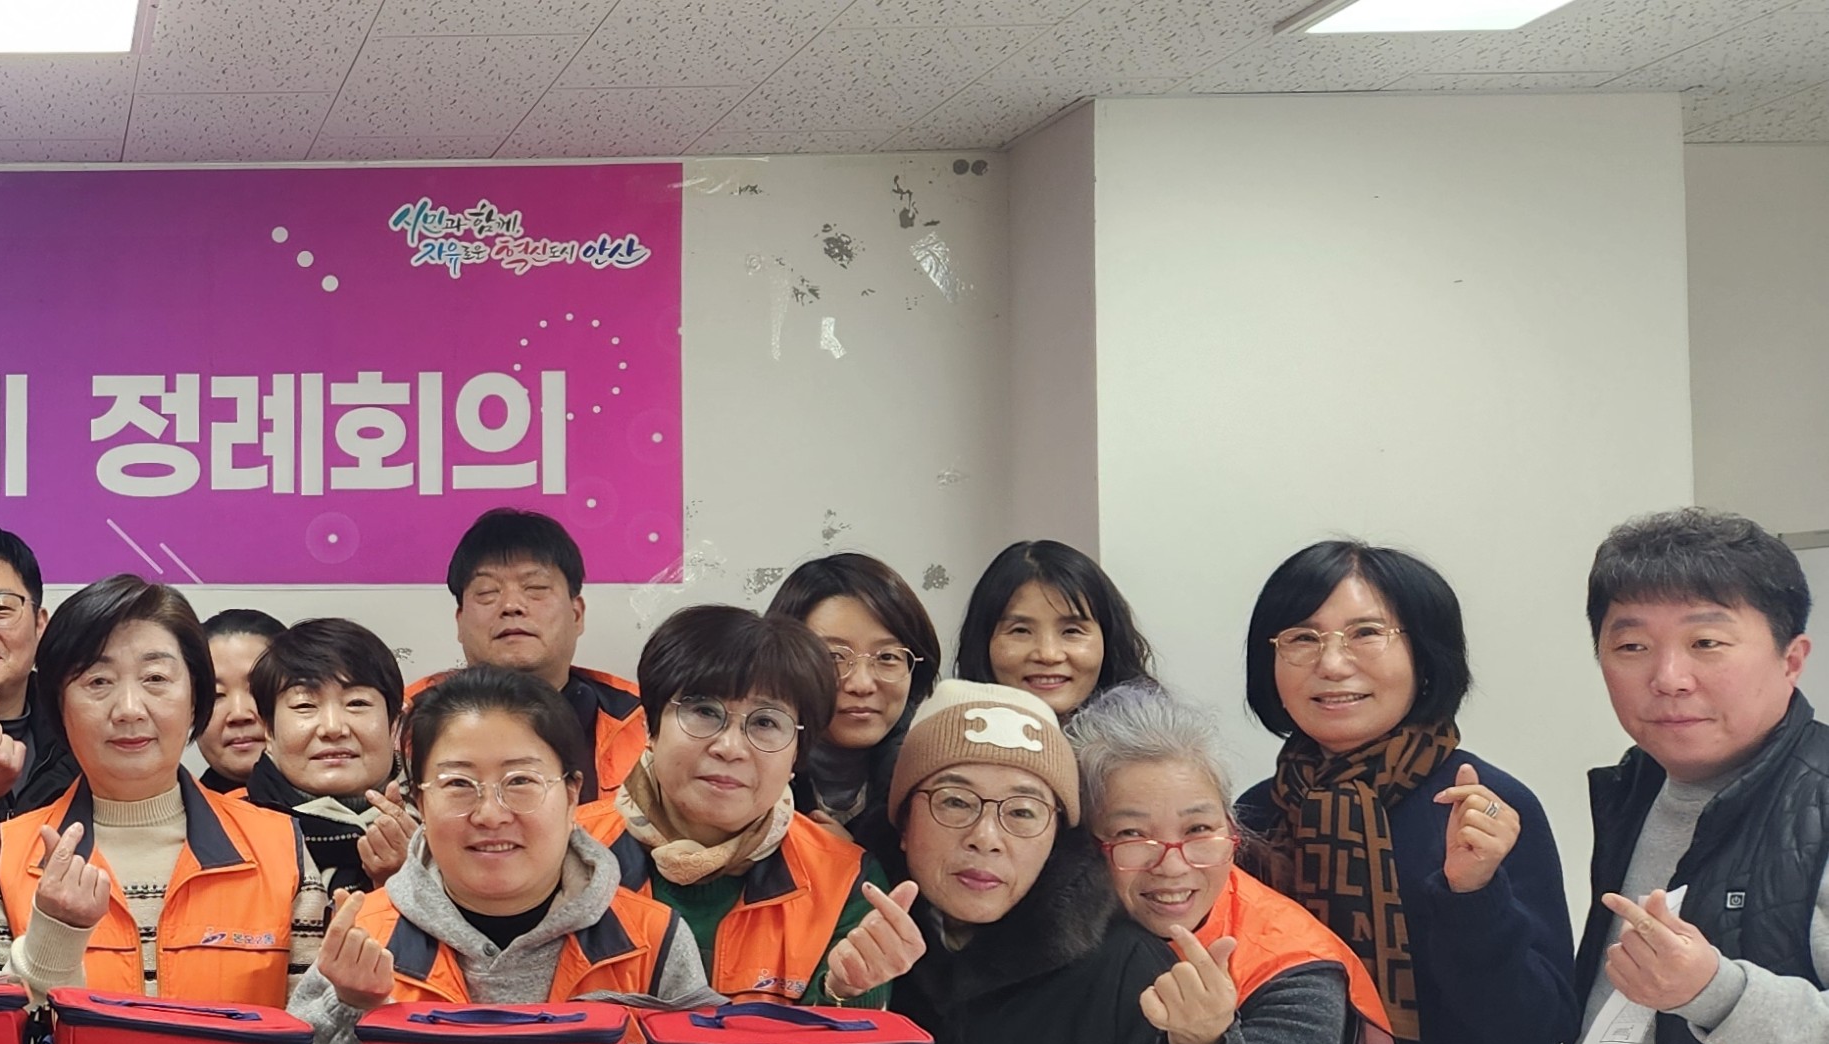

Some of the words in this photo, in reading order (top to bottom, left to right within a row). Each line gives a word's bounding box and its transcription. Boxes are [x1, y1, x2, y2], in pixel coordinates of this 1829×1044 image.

[392, 200, 467, 245] 시민과
[582, 238, 649, 266] 안산
[90, 370, 568, 497] 정례회의
